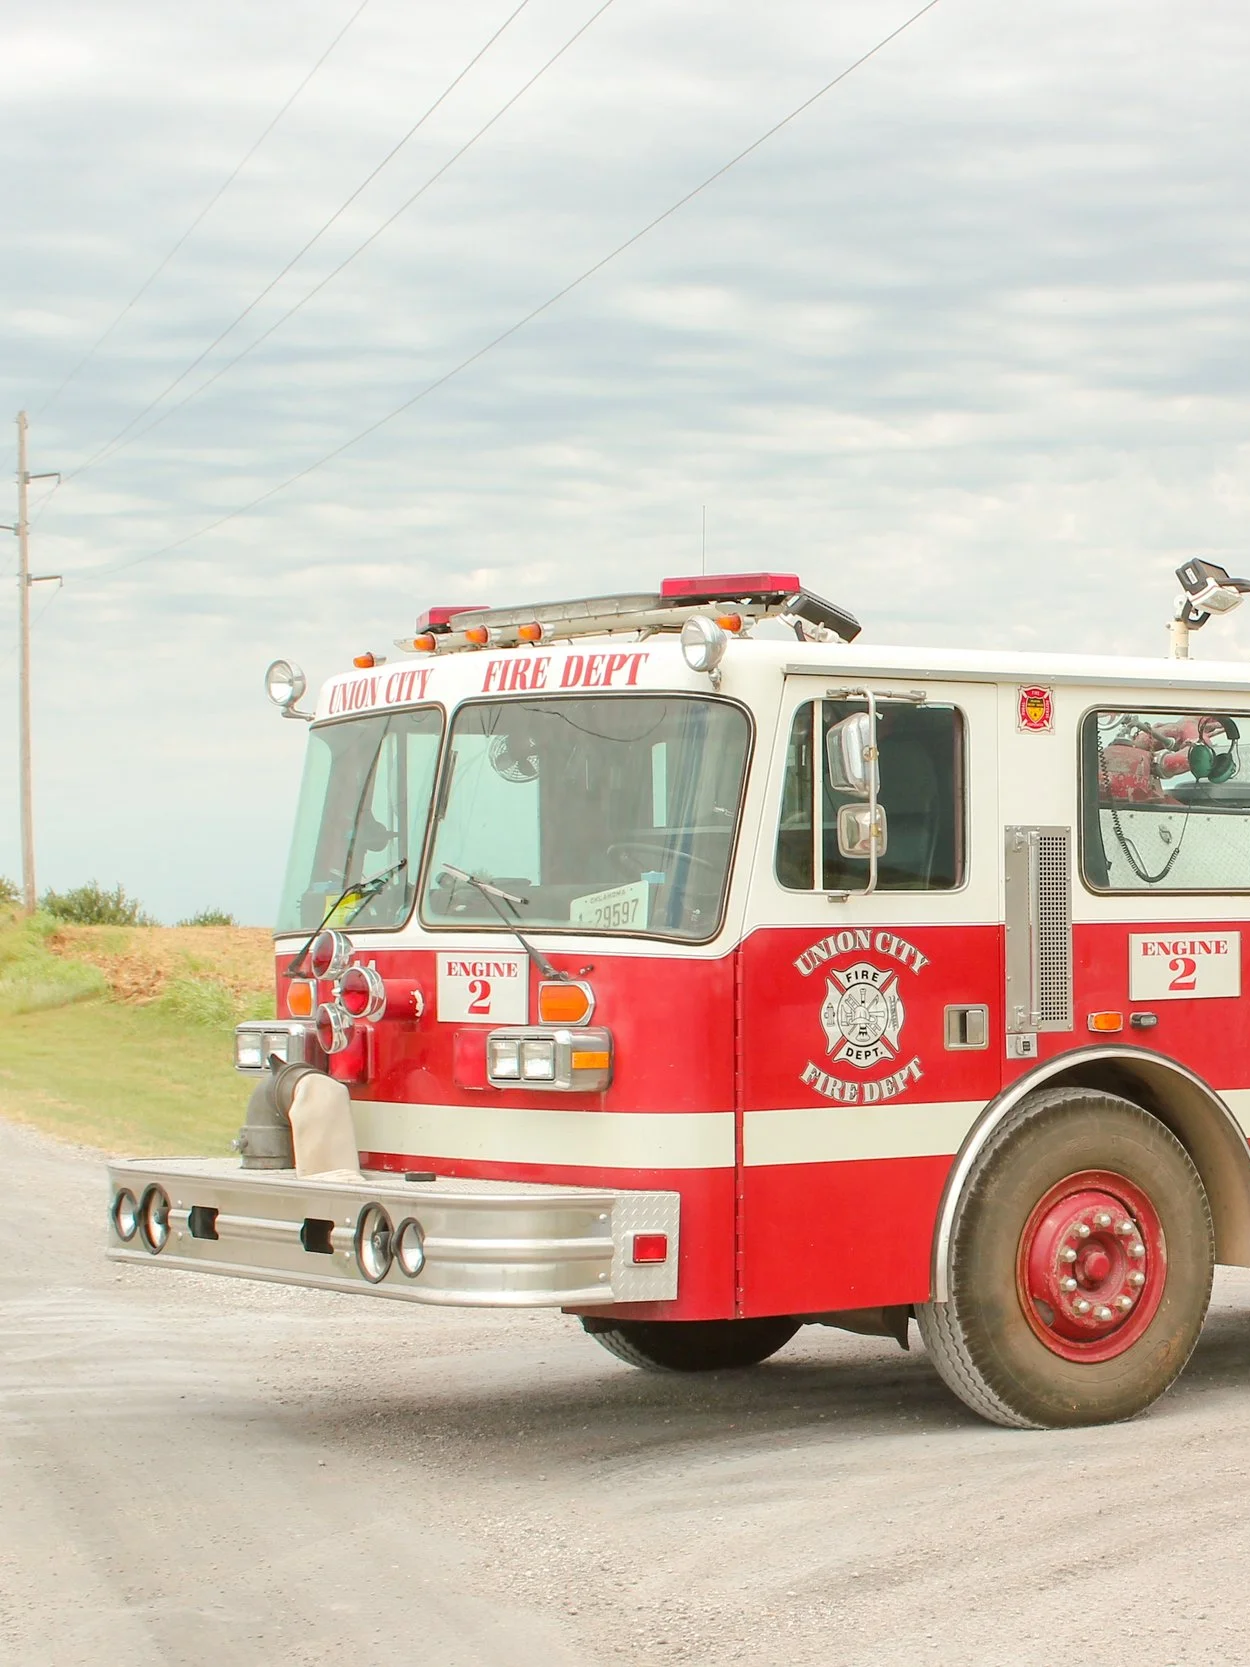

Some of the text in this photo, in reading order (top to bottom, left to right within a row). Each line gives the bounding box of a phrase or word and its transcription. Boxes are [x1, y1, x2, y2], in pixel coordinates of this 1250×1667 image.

[481, 652, 650, 693] FIRE DEPT
[328, 667, 434, 714] UNION CITY
[792, 928, 930, 977] UNION CITY
[1142, 940, 1229, 956] ENGINE
[446, 961, 518, 977] ENGINE
[845, 970, 880, 982] FIRE
[1168, 957, 1197, 991] 2
[467, 979, 491, 1015] 2
[845, 1047, 883, 1060] DEPT.
[799, 1055, 924, 1103] FIRE DEPT
